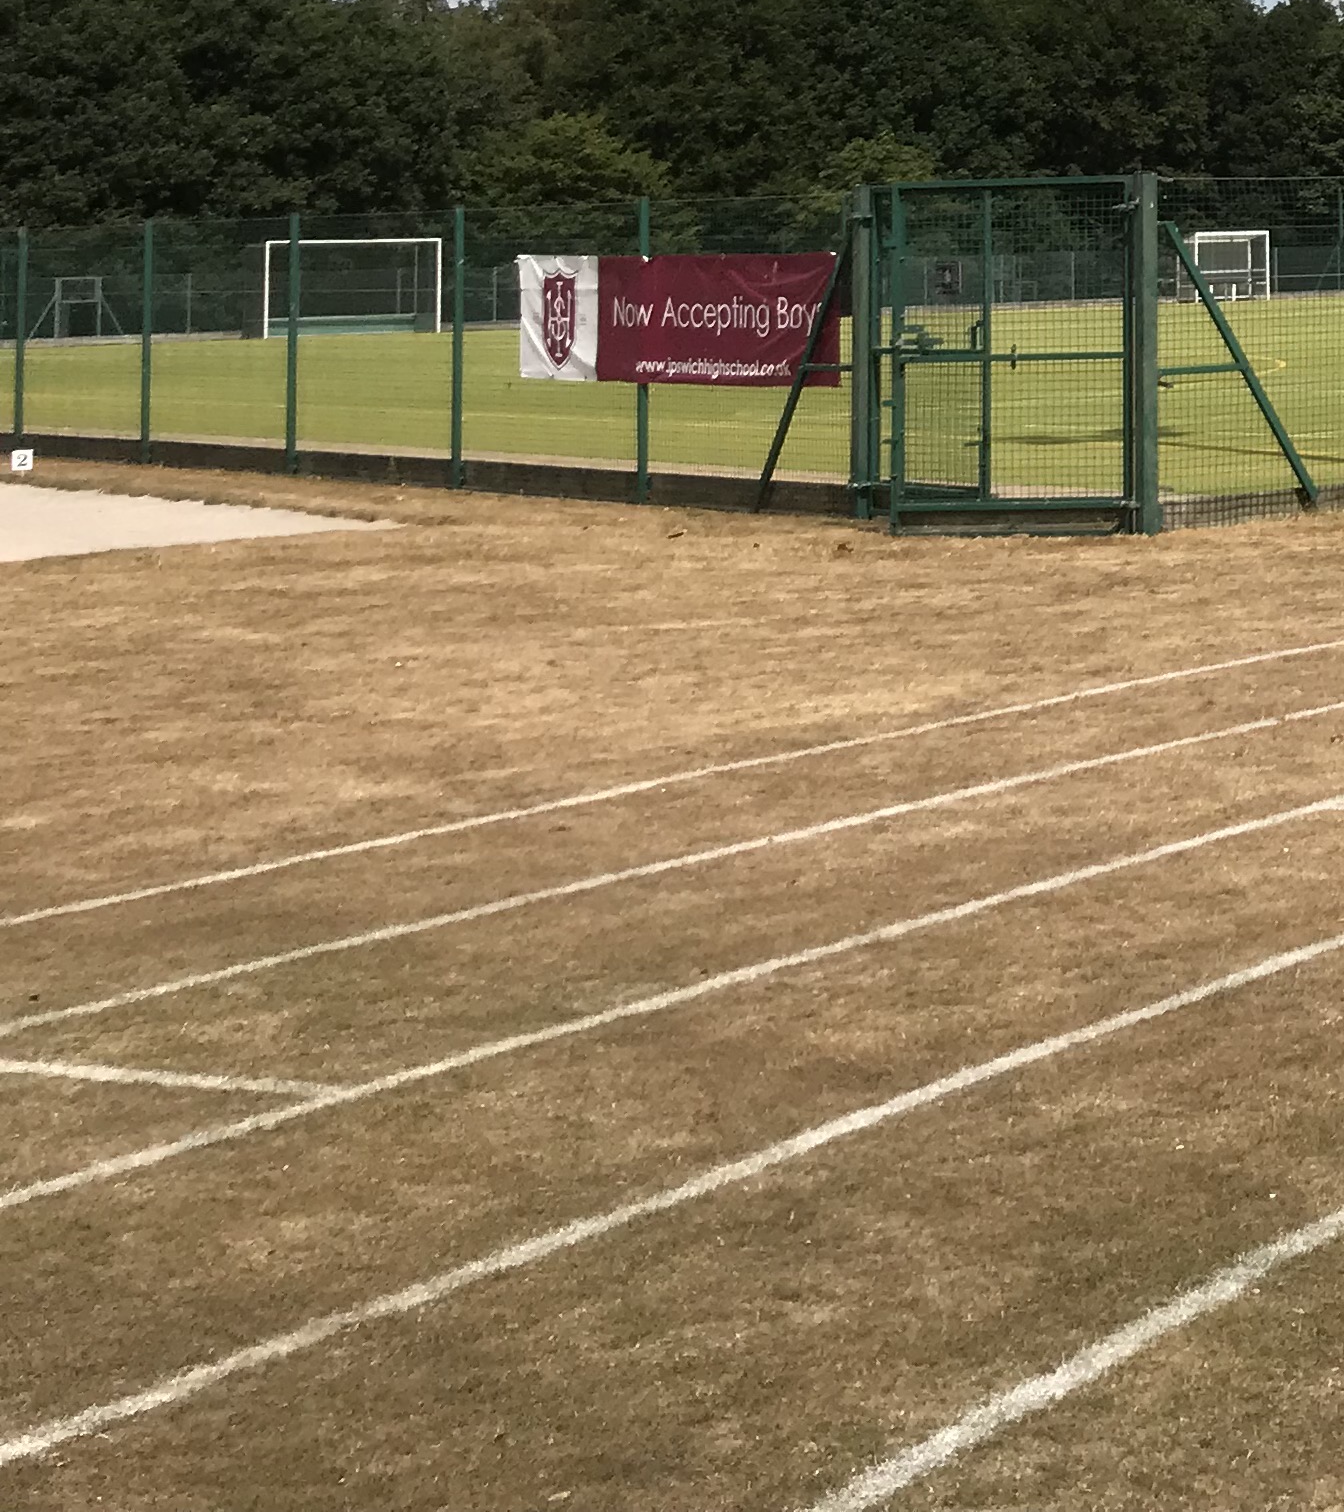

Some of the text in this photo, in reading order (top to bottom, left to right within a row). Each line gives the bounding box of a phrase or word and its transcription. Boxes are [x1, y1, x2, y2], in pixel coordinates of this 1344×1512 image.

[613, 296, 654, 328] Now
[661, 295, 770, 338] Accepting
[16, 453, 28, 468] 2
